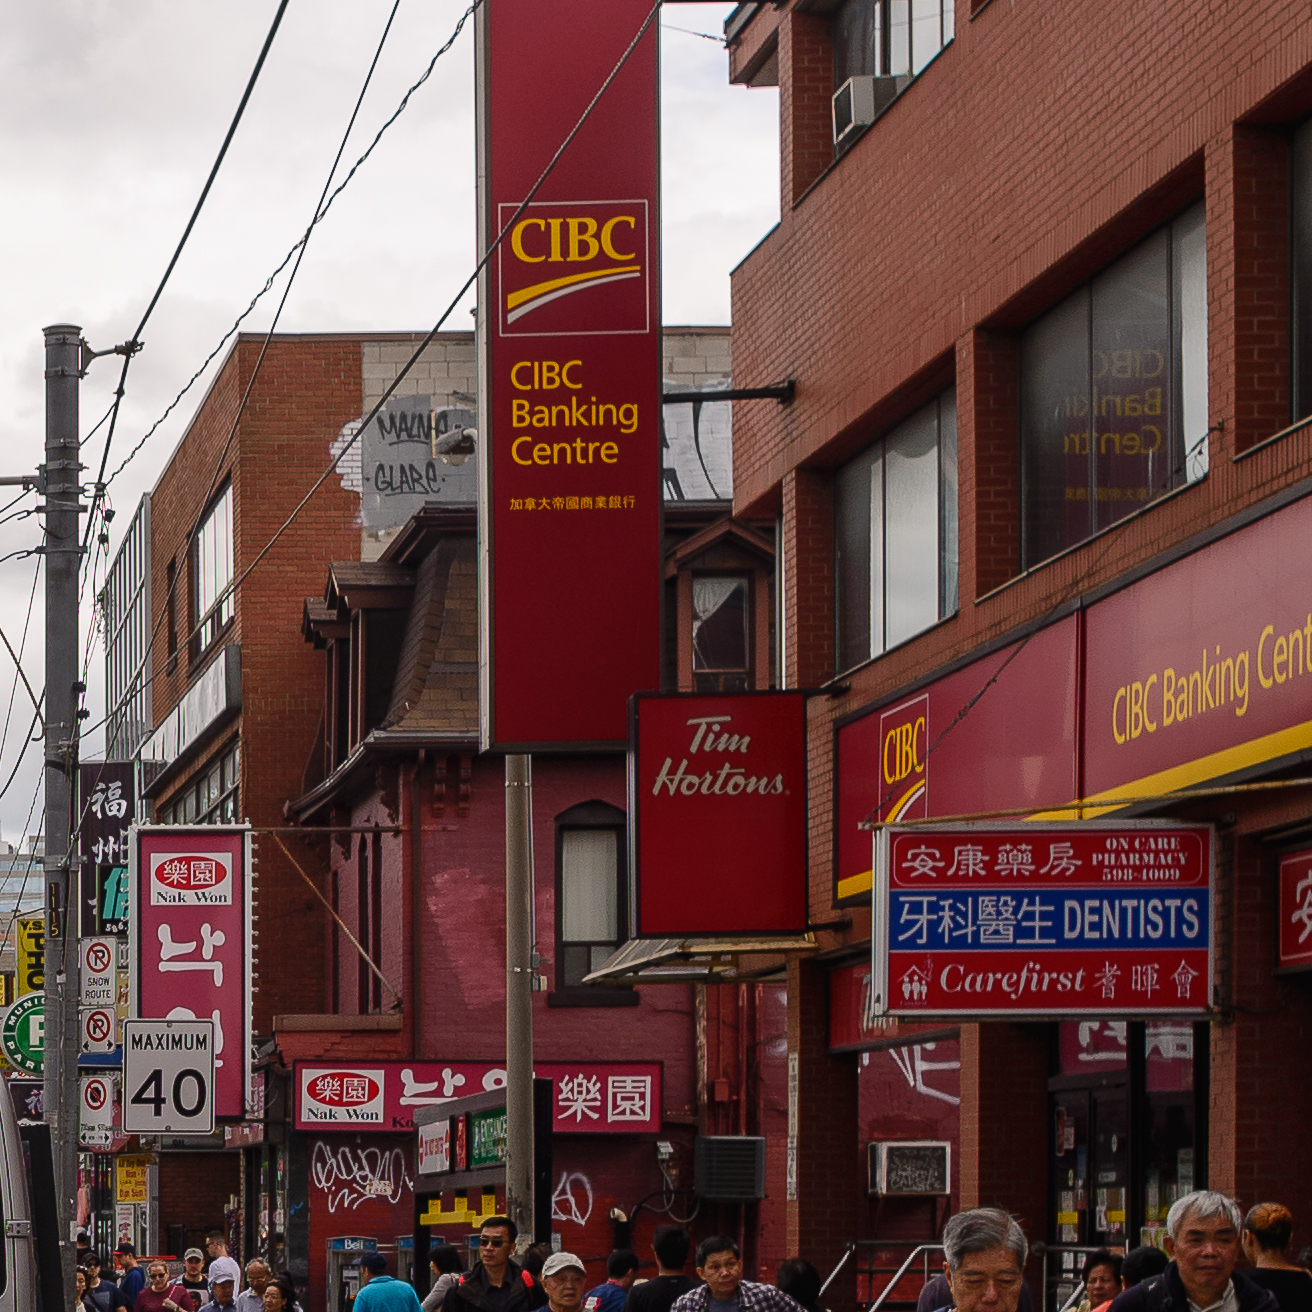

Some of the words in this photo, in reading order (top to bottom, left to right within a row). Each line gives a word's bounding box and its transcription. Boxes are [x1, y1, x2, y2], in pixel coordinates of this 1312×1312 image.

[511, 215, 636, 263] CIBC
[510, 359, 583, 390] CIBC
[511, 396, 639, 434] Banking
[511, 436, 619, 466] Centre
[1112, 673, 1158, 745] CIBC
[1163, 644, 1249, 718] Banking
[686, 714, 752, 754] Tim
[882, 716, 926, 785] CIBC
[651, 756, 784, 797] Hortons
[901, 842, 1083, 878] 安康藥房
[1091, 852, 1189, 867] PHARMACY
[1105, 837, 1130, 851] ON
[1135, 836, 1181, 851] CARE
[162, 860, 216, 886] 樂園
[156, 891, 186, 904] Nak
[195, 891, 228, 904] Won
[897, 895, 1057, 944] 牙科醫生
[1063, 898, 1200, 940] DENTISTS
[85, 989, 111, 999] ROUTE
[87, 977, 110, 987] SNOW
[939, 960, 1086, 999] Carefirst
[131, 1033, 208, 1051] MAXIMUM
[130, 1067, 207, 1119] 40
[314, 1075, 370, 1103] 樂園
[556, 1073, 653, 1125] 樂園
[306, 1107, 337, 1121] Nak
[346, 1107, 379, 1121] Won
[344, 1238, 364, 1250] Bell
